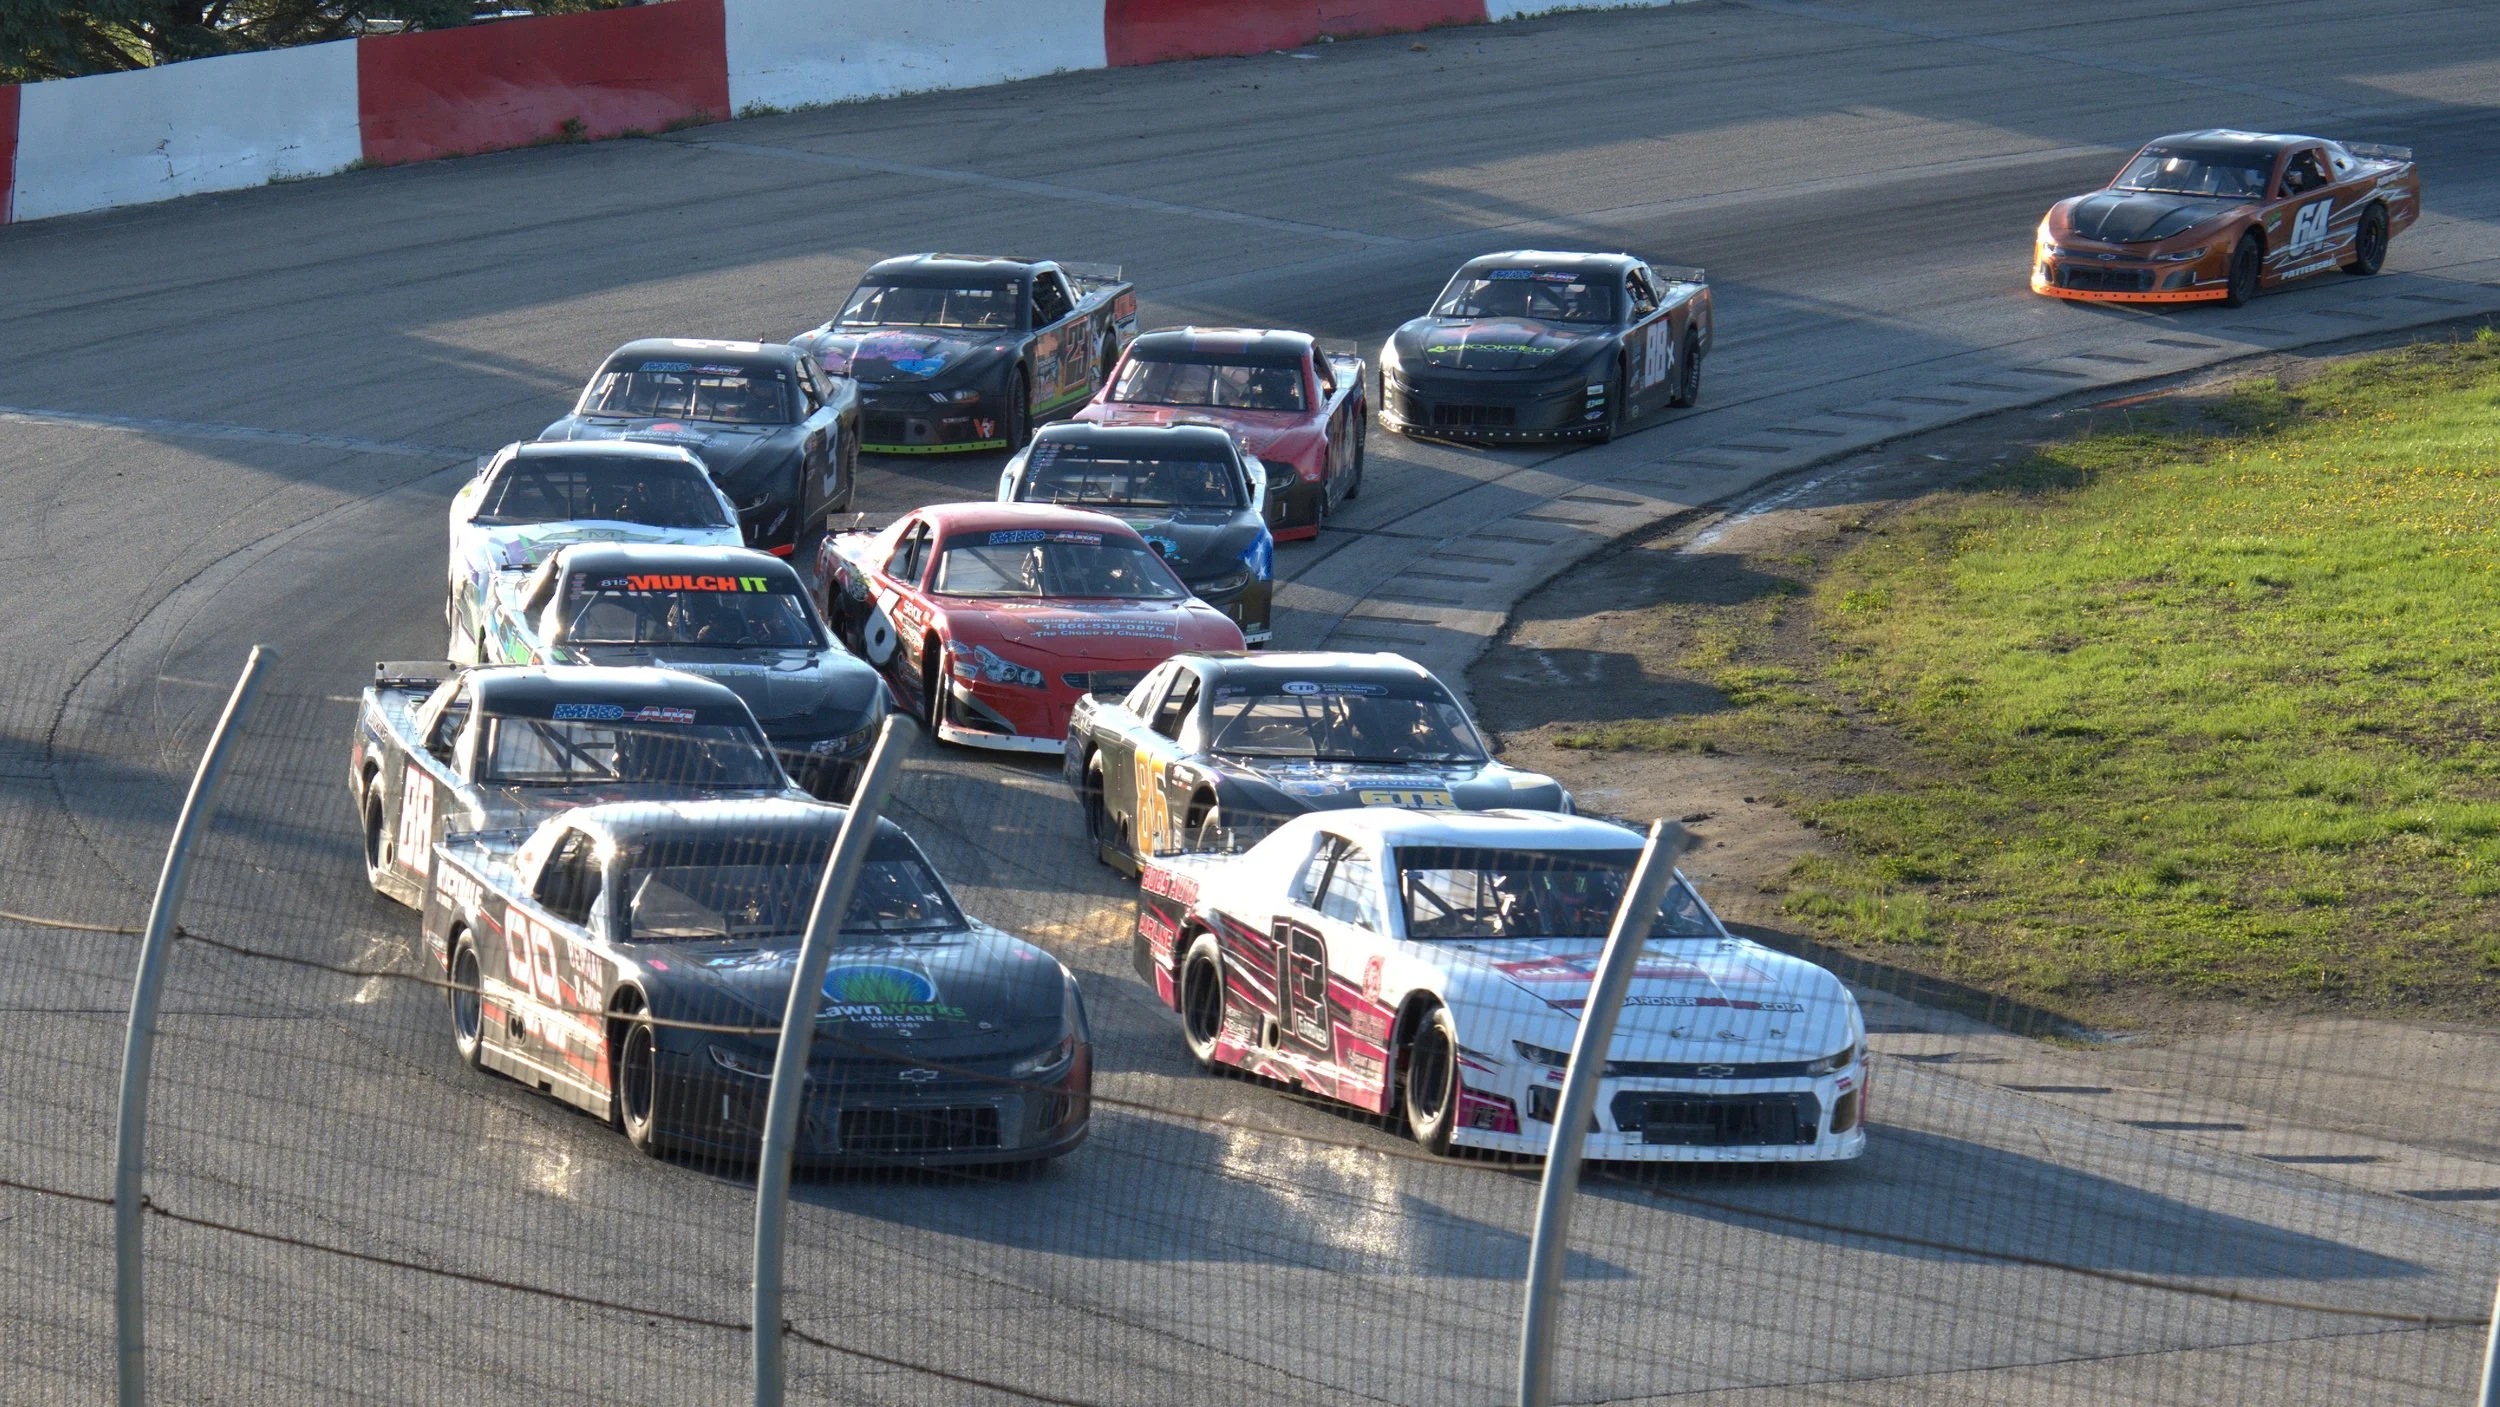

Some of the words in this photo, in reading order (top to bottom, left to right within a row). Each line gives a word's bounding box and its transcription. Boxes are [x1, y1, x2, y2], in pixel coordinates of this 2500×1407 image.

[2289, 199, 2334, 258] 64
[823, 421, 839, 498] 3
[989, 530, 1102, 546] MID-AM
[627, 574, 737, 592] MULCH
[738, 576, 768, 593] IT
[864, 588, 901, 665] 6
[553, 704, 696, 725] MID-AM
[398, 765, 434, 878] 88
[1135, 749, 1170, 858] 86
[1271, 915, 1329, 1051] 13
[850, 1013, 935, 1022] LAWNCARE
